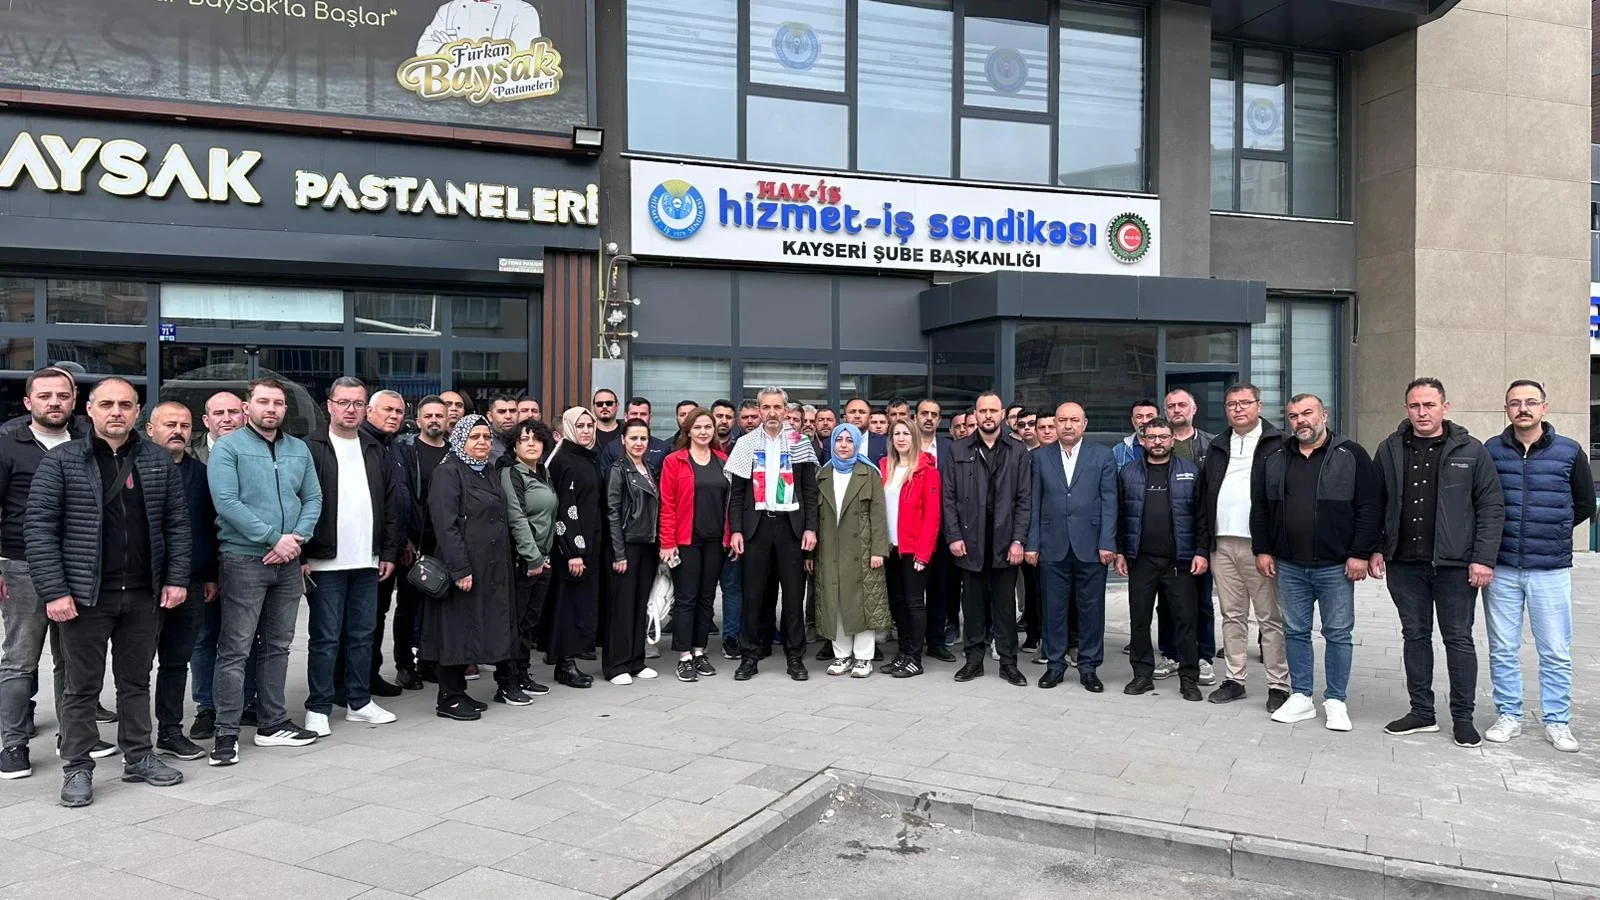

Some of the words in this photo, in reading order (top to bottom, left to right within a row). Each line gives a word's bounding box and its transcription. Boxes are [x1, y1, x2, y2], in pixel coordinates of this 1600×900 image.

[189, 0, 306, 18] aysak'la
[452, 42, 510, 68] Furkan
[404, 41, 556, 103] Baysak
[493, 79, 553, 96] Pastaneleri
[295, 169, 599, 226] PASTANELERİ
[719, 187, 916, 245] hizmet-iş
[929, 207, 1097, 247] sendikası
[782, 240, 867, 259] KAYSERİ
[873, 245, 924, 263] ŞUBE
[930, 247, 1041, 268] BAŞKANLIĞI
